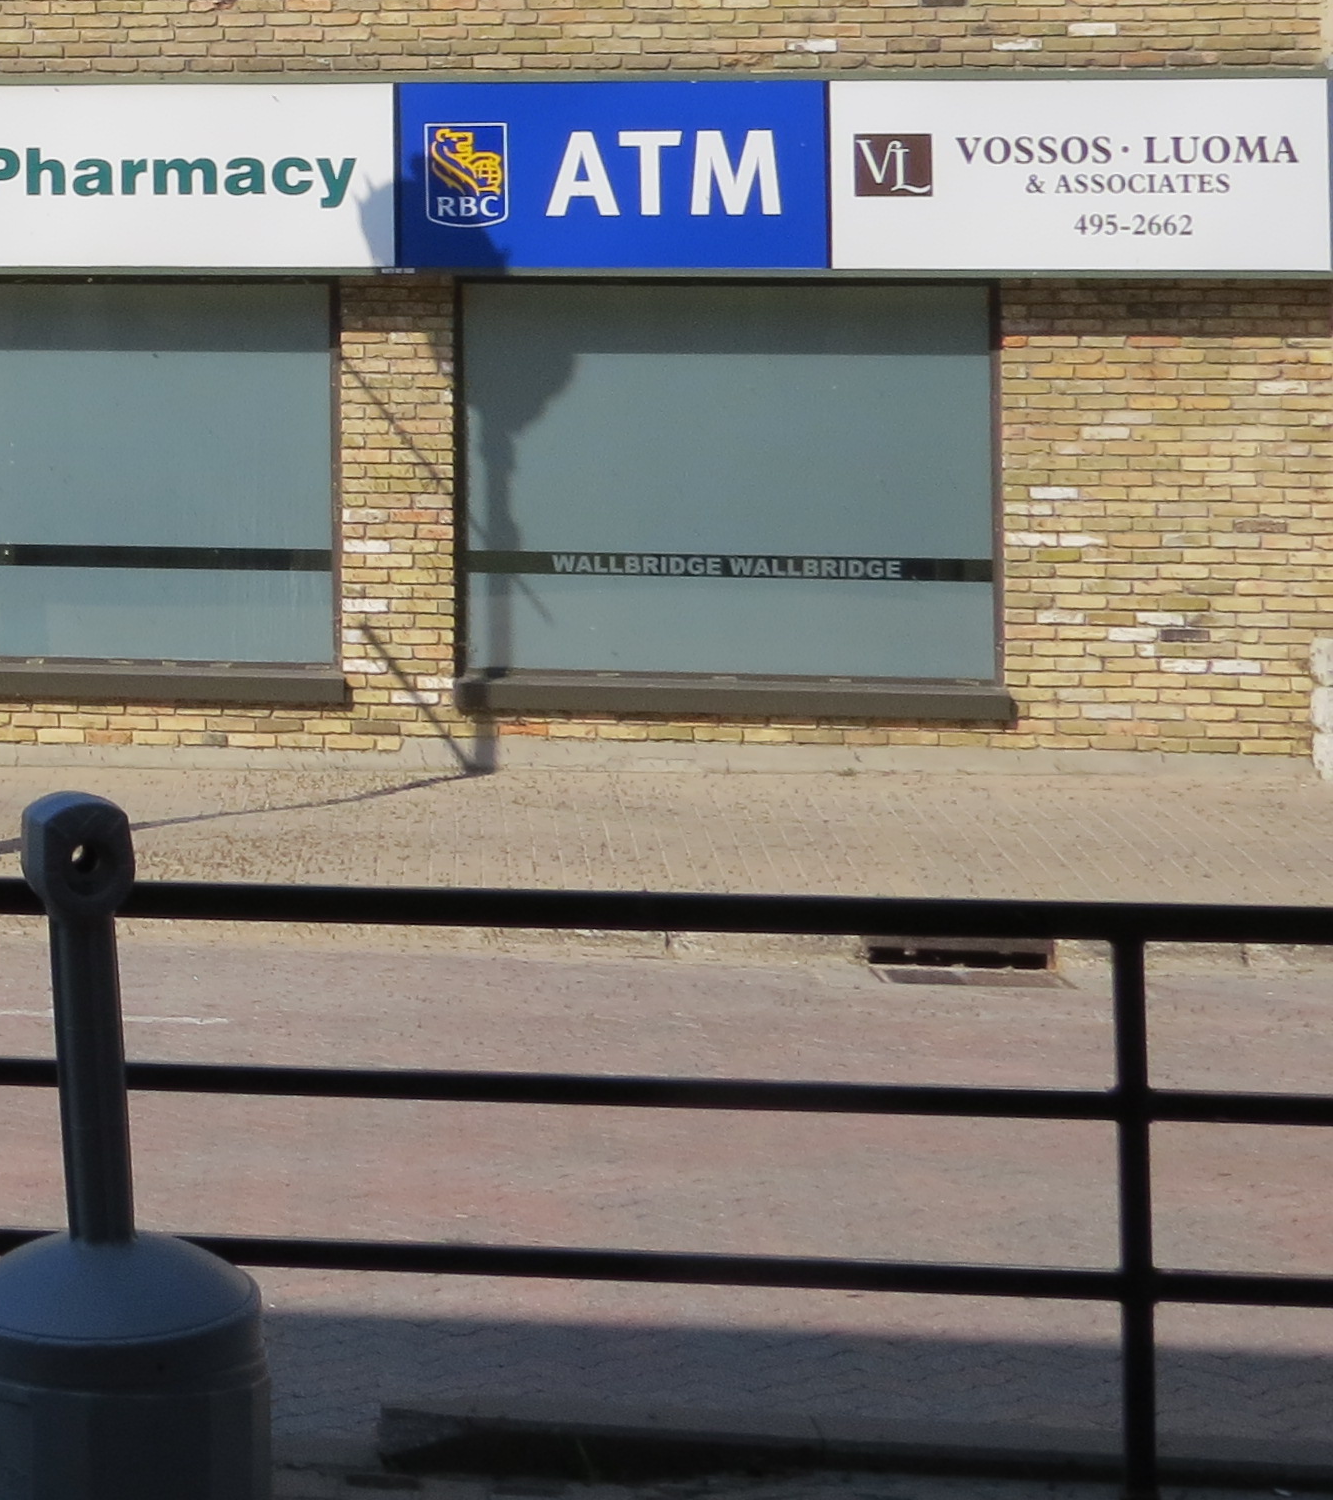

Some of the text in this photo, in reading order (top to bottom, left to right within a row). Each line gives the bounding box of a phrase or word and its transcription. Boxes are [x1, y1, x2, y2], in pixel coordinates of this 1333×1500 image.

[1143, 135, 1300, 165] LUOMA
[545, 129, 782, 217] ATM
[1025, 173, 1231, 195] & ASSOCIATES
[436, 195, 500, 217] RBC
[1073, 214, 1193, 236] 495-2662
[551, 554, 902, 579] WALLBRIDGE WALLBRIDGE
